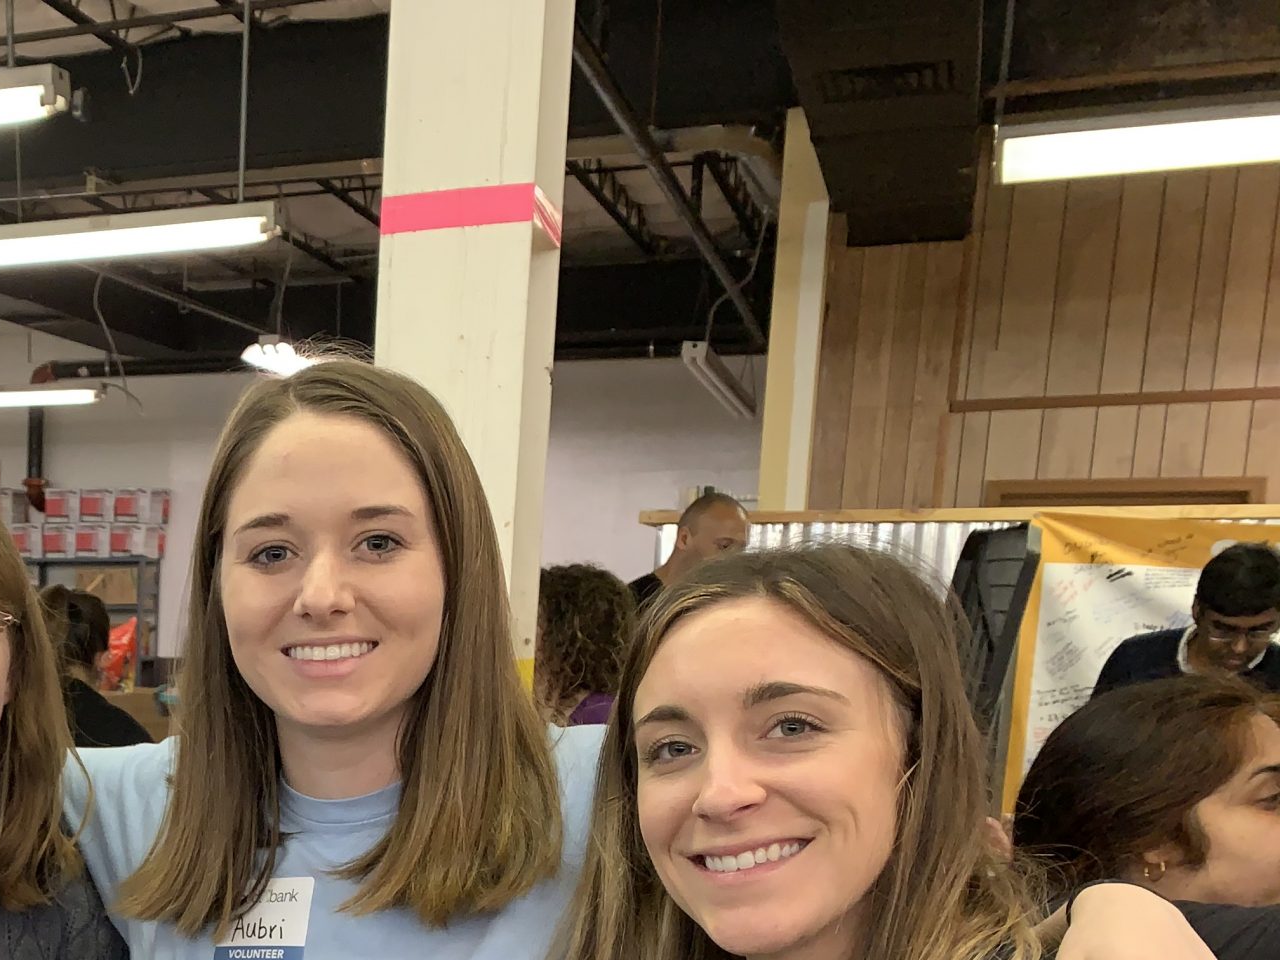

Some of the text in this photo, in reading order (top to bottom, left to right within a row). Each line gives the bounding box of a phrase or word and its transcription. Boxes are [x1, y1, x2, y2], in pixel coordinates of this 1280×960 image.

[269, 889, 299, 903] bank
[231, 914, 286, 942] Aubri
[228, 949, 285, 960] VOLUNTEER
